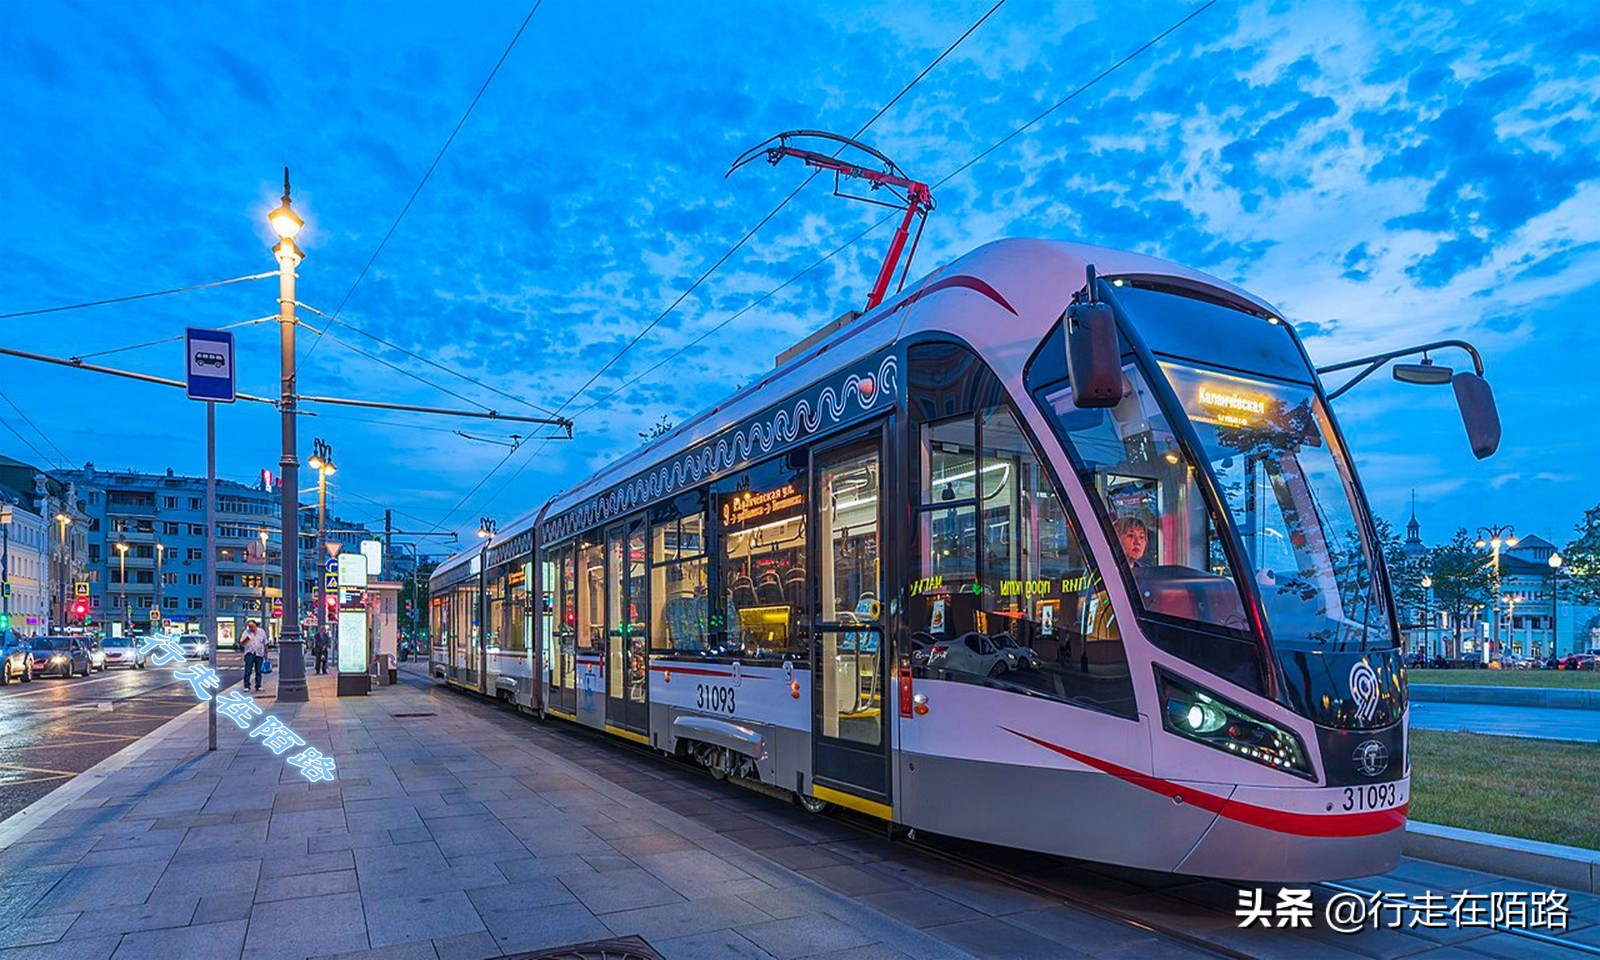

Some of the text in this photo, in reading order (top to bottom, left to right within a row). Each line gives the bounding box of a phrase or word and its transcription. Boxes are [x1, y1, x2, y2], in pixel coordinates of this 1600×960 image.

[723, 503, 730, 526] 9
[697, 683, 735, 714] 31093
[1342, 783, 1395, 811] 31093
